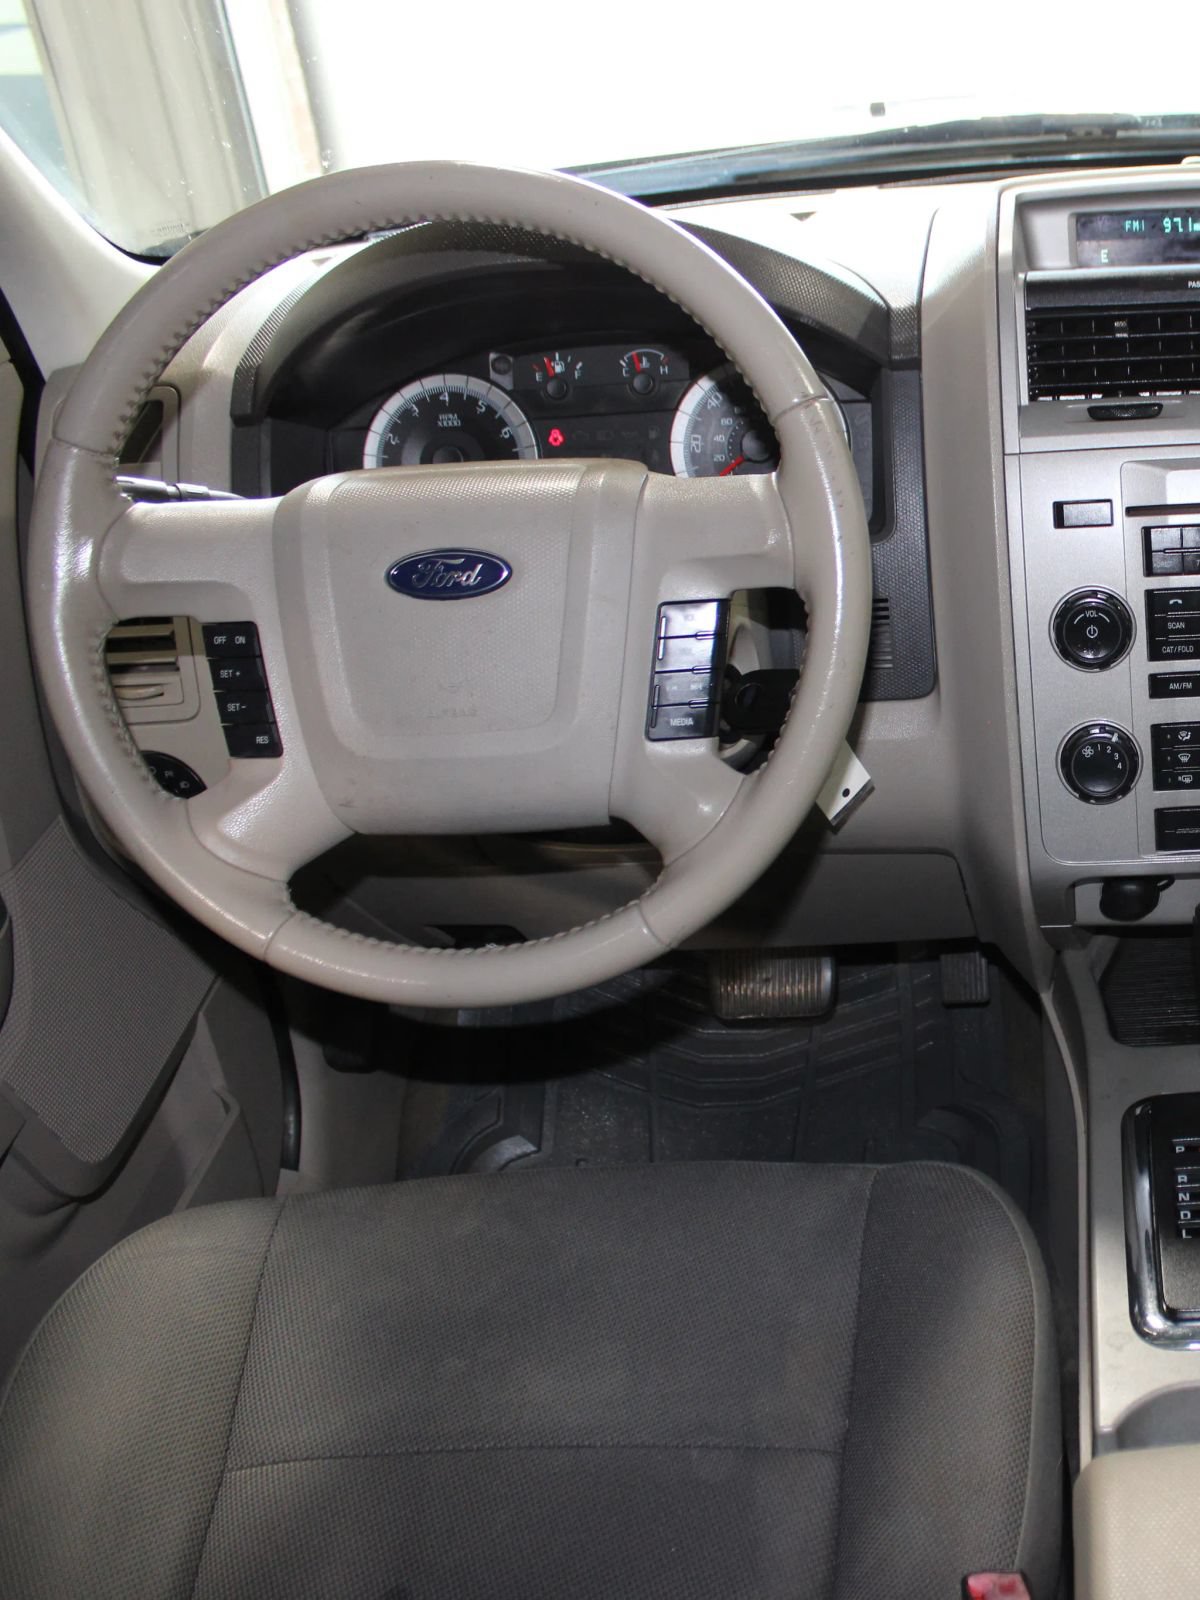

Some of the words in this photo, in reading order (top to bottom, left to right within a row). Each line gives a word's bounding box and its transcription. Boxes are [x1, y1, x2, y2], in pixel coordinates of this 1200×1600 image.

[1101, 249, 1109, 263] E
[660, 365, 669, 375] H
[536, 371, 543, 382] E
[575, 370, 582, 380] F
[440, 391, 449, 407] 4
[707, 391, 723, 410] 40
[411, 403, 419, 417] 3
[476, 400, 488, 414] 5
[500, 427, 513, 438] 6
[385, 433, 400, 445] 2
[691, 434, 702, 453] 20
[412, 558, 483, 589] Ford
[1085, 610, 1098, 618] VOL
[213, 636, 227, 645] OFF
[235, 636, 246, 644] ON
[1162, 645, 1194, 653] CAT/FOLD
[220, 669, 233, 678] SET
[1169, 682, 1192, 690] AM/FM
[227, 703, 240, 711] SET
[670, 717, 694, 727] MEDIA
[256, 736, 269, 744] RES
[1106, 745, 1111, 753] 2
[1114, 752, 1119, 760] 3
[1178, 1175, 1188, 1183] R
[1178, 1193, 1190, 1201] N
[1180, 1210, 1191, 1219] D
[1182, 1229, 1192, 1238] L
